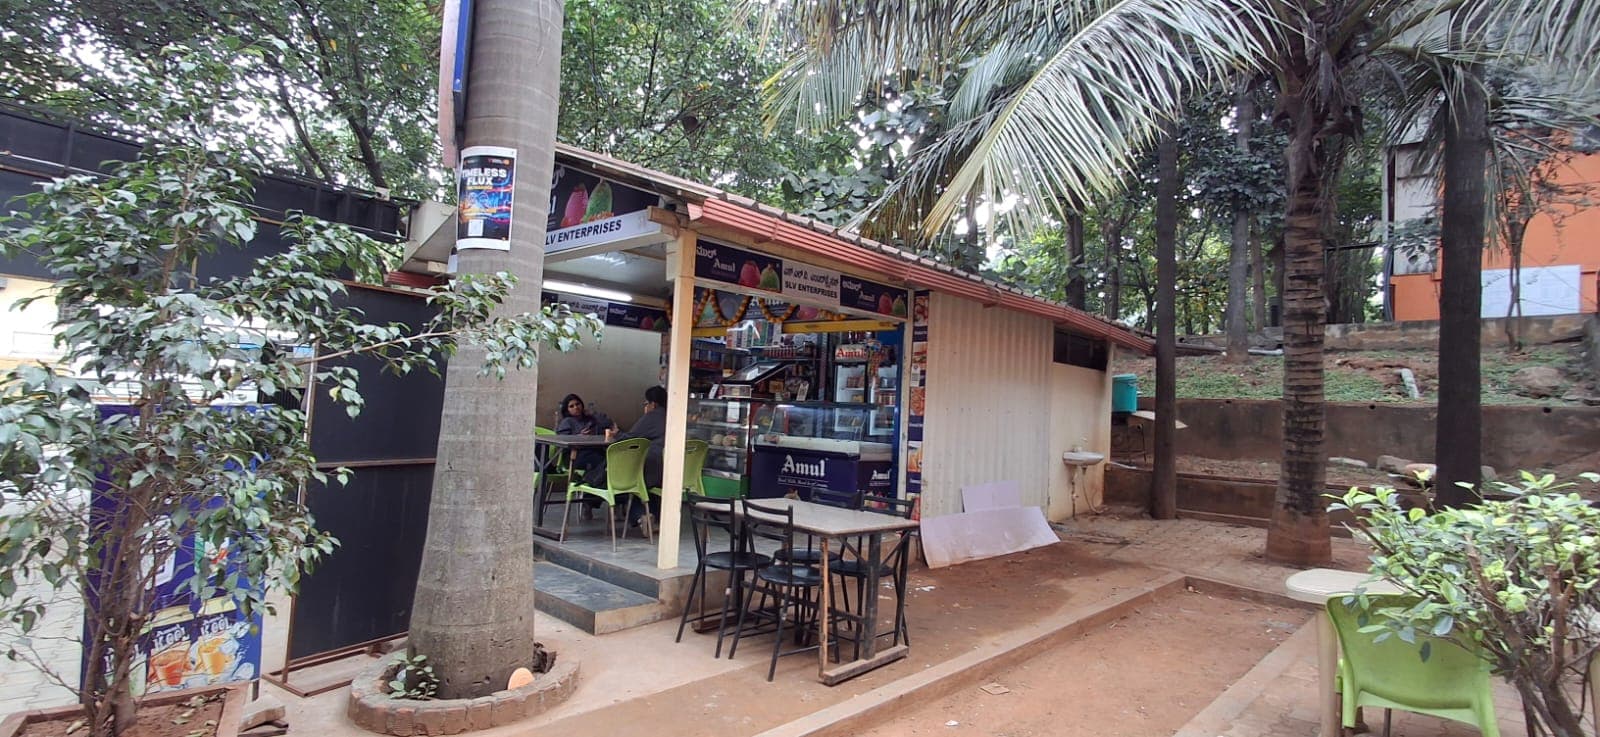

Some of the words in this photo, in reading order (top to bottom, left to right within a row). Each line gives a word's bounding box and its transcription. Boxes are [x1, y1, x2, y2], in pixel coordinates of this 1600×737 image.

[462, 167, 507, 179] TIMELESS
[466, 176, 493, 186] FLUX
[544, 233, 556, 246] LV
[557, 219, 622, 243] ENTERPRISES
[712, 258, 736, 273] Amul
[798, 283, 838, 299] ENTERPRISES
[837, 348, 866, 358] Amul
[781, 454, 826, 478] Amul
